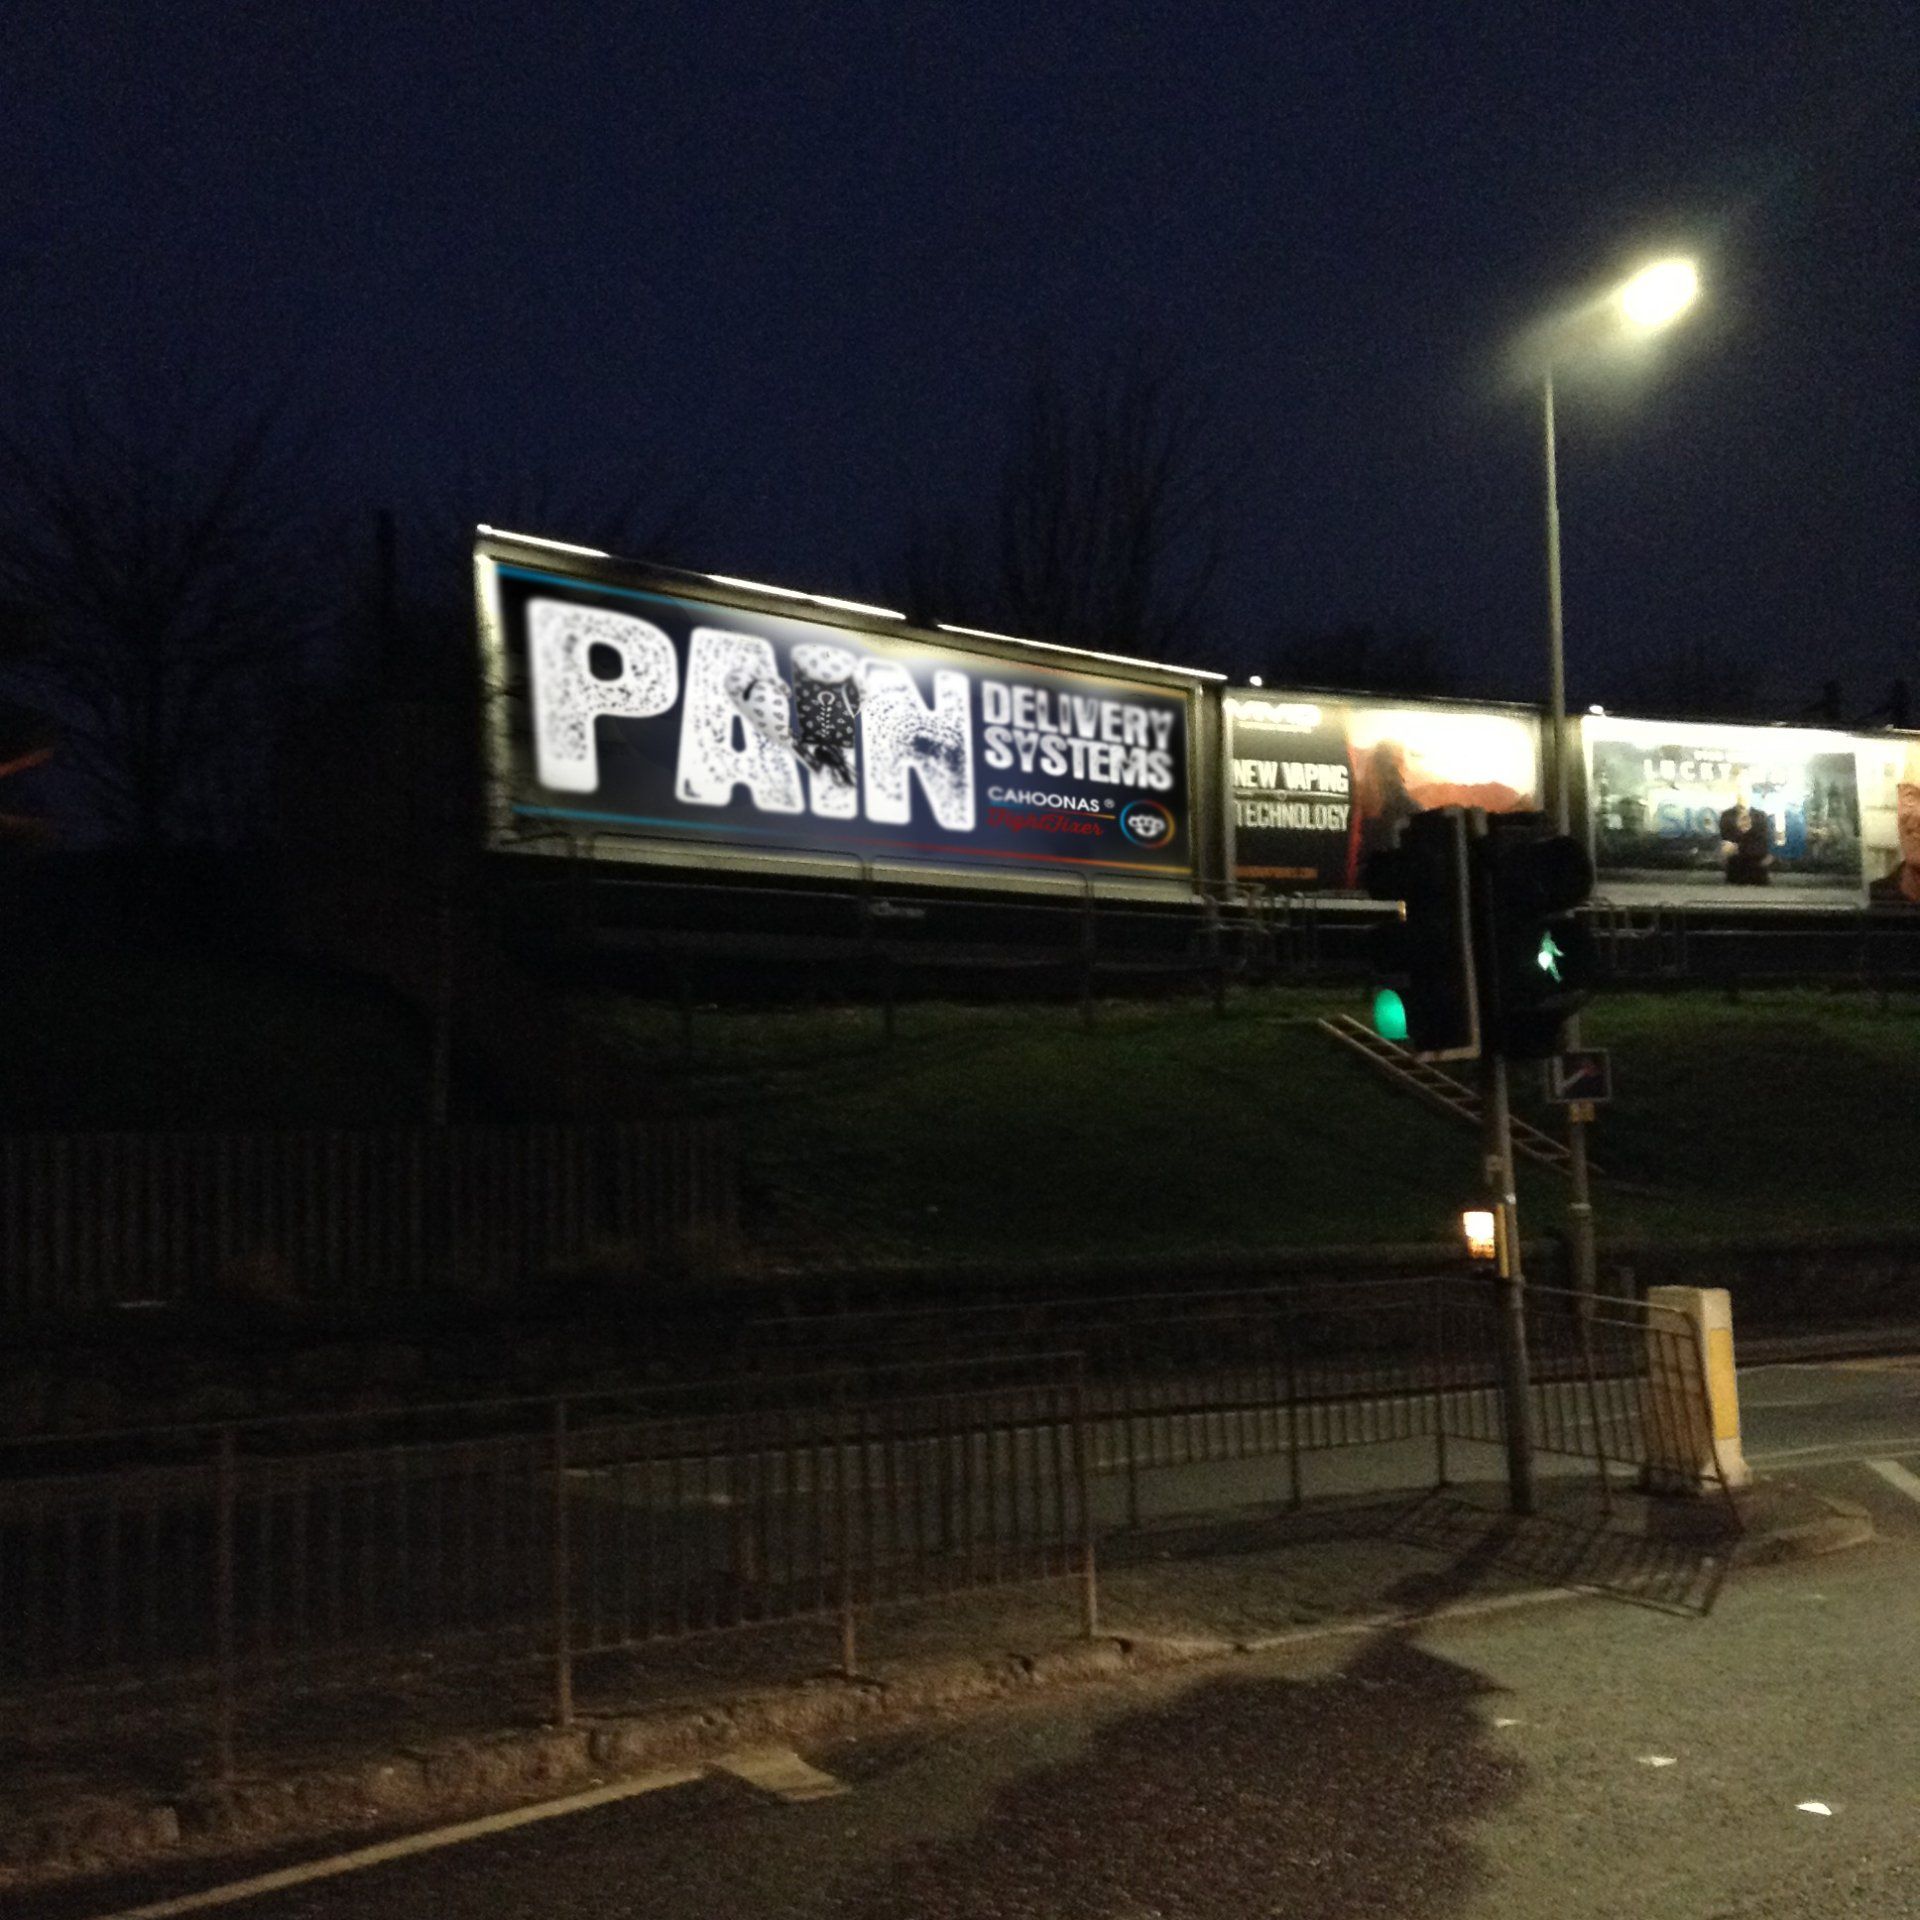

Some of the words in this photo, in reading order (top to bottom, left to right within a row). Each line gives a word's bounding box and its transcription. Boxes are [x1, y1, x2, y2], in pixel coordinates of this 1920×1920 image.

[526, 597, 977, 832] PAIN
[982, 680, 1174, 750] DELIVERY
[984, 725, 1174, 791] SYSTEMS
[1643, 759, 1732, 782] LUCKY
[1232, 759, 1278, 789] NEW
[987, 786, 1100, 812] CAHOONAS
[1234, 801, 1351, 831] TECHNOLOGY
